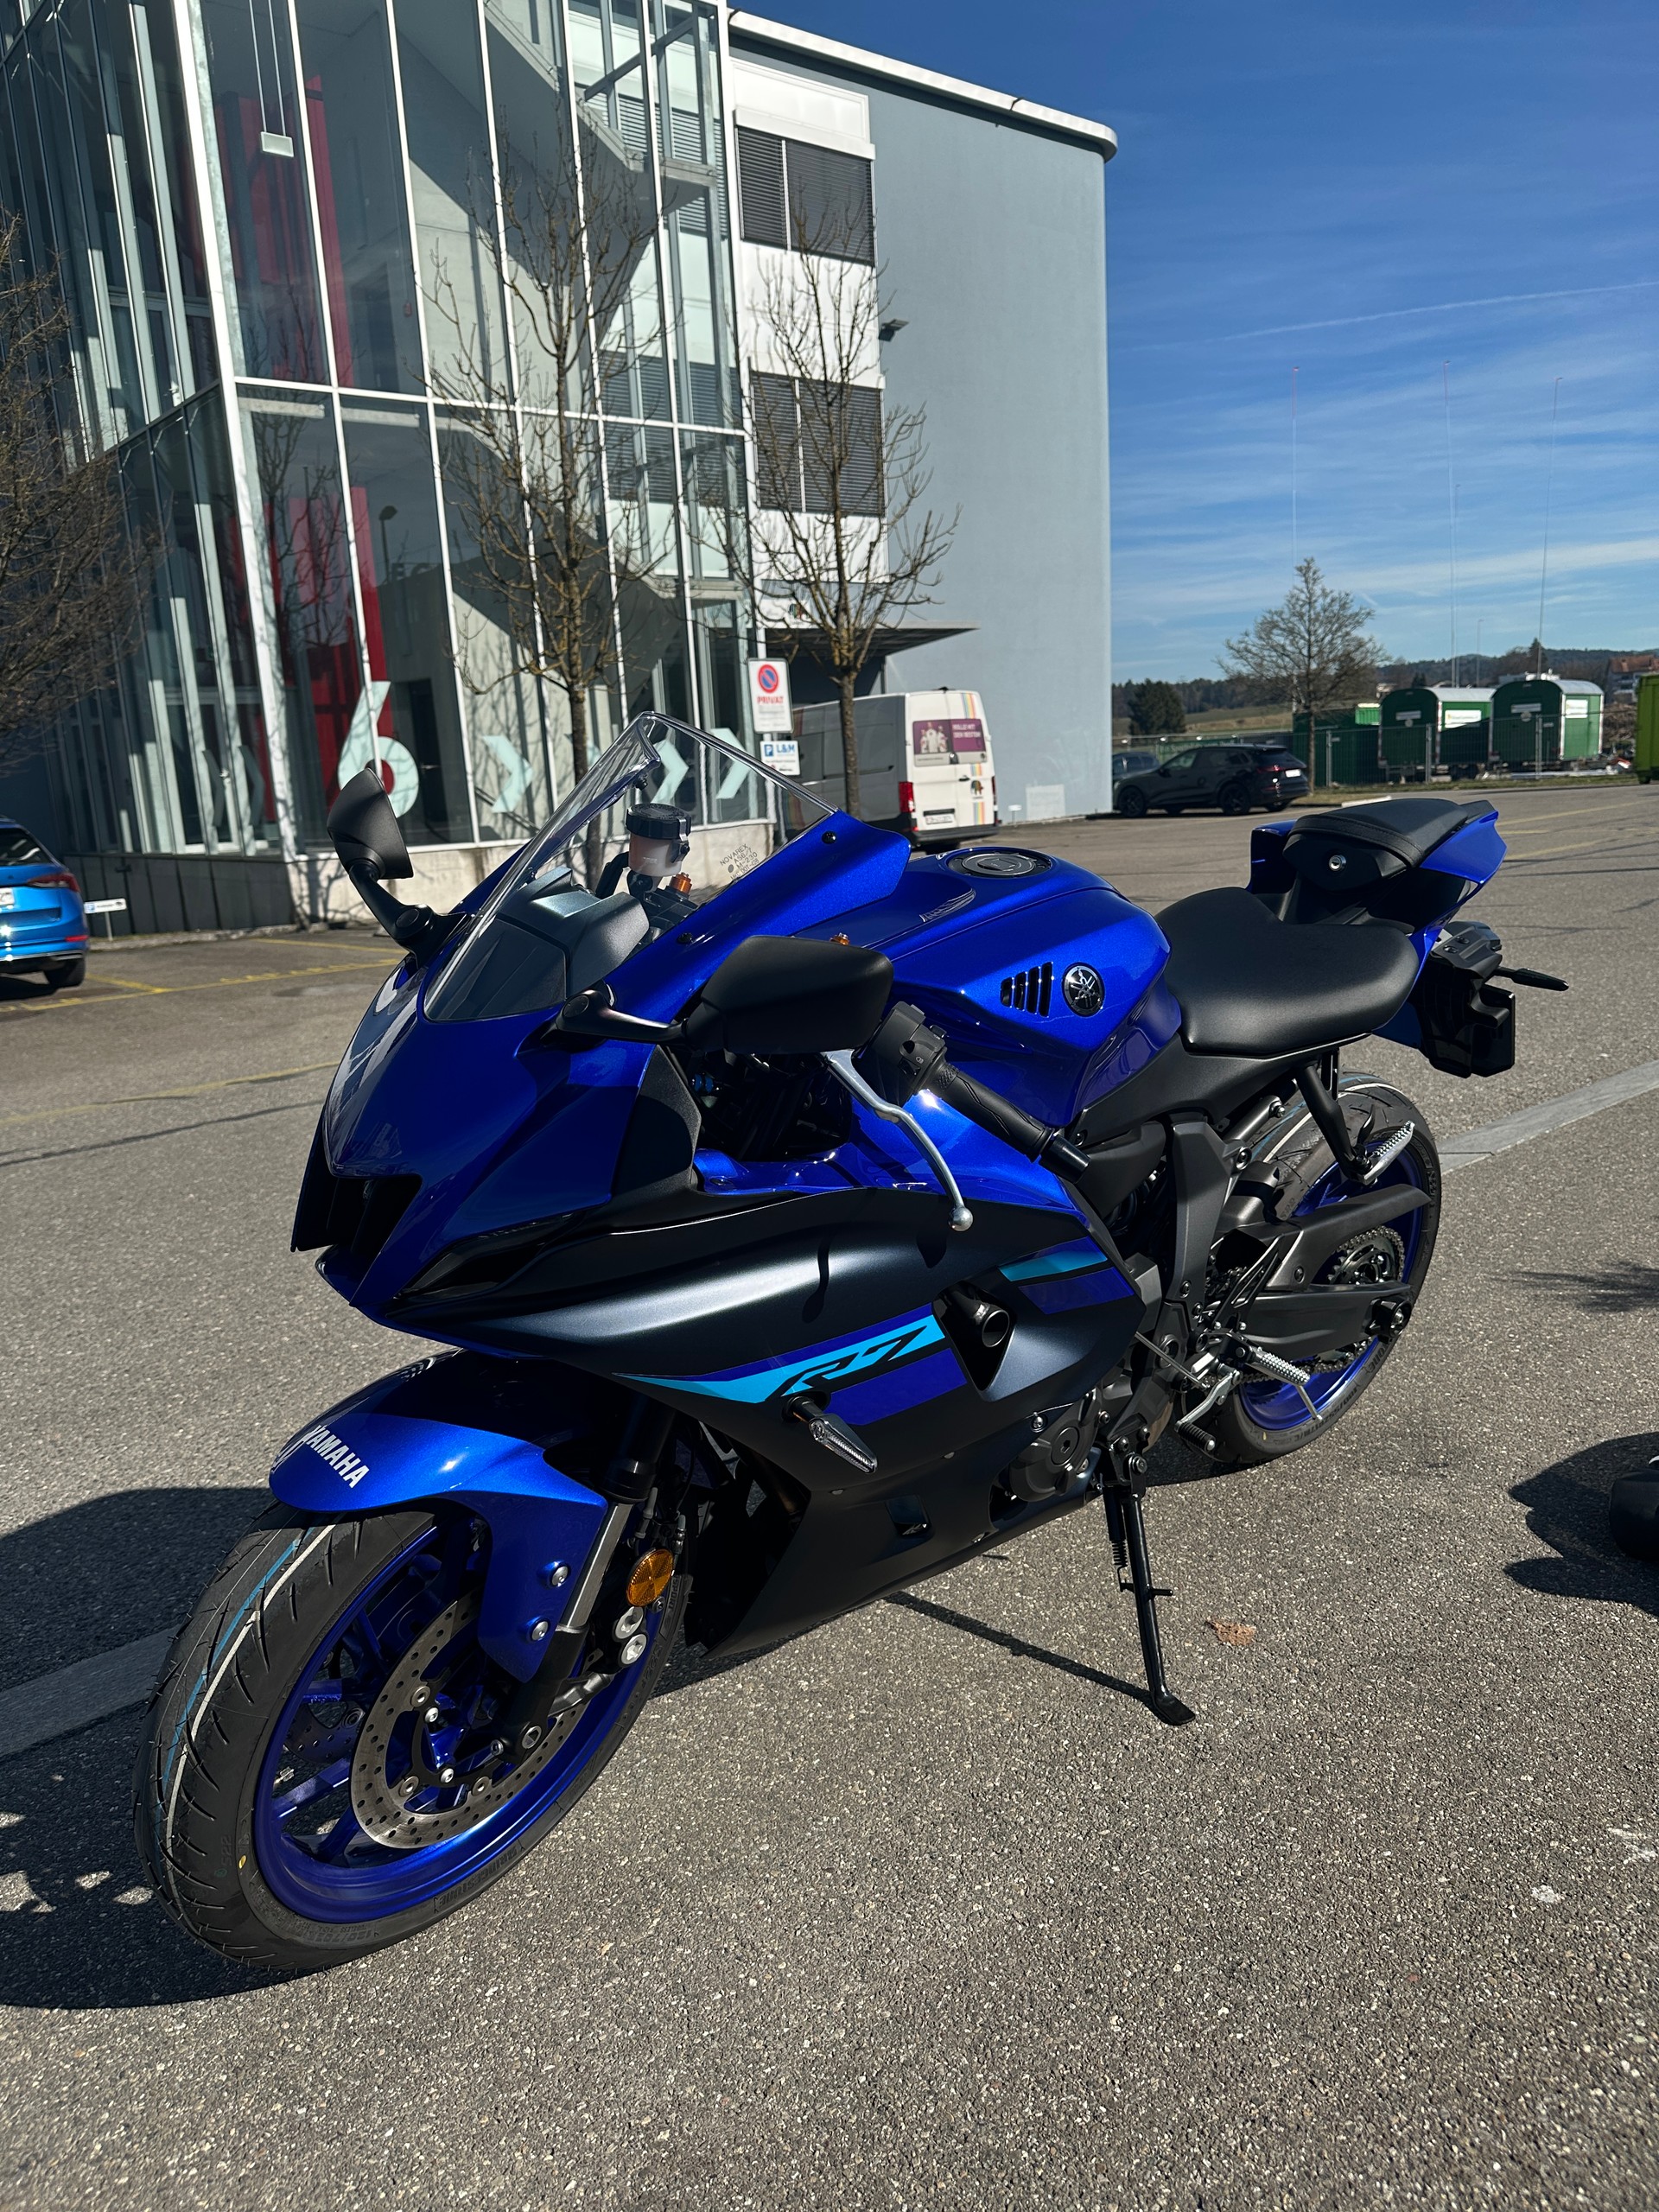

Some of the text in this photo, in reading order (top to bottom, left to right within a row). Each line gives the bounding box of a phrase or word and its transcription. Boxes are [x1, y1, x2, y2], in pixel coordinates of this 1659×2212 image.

[776, 744, 795, 753] L&M
[720, 843, 748, 866] NOVAREX
[736, 852, 758, 869] M-230
[765, 1325, 927, 1401] R7
[303, 1425, 370, 1488] YAMAHA
[439, 1847, 517, 1905] BRIDGESTONE
